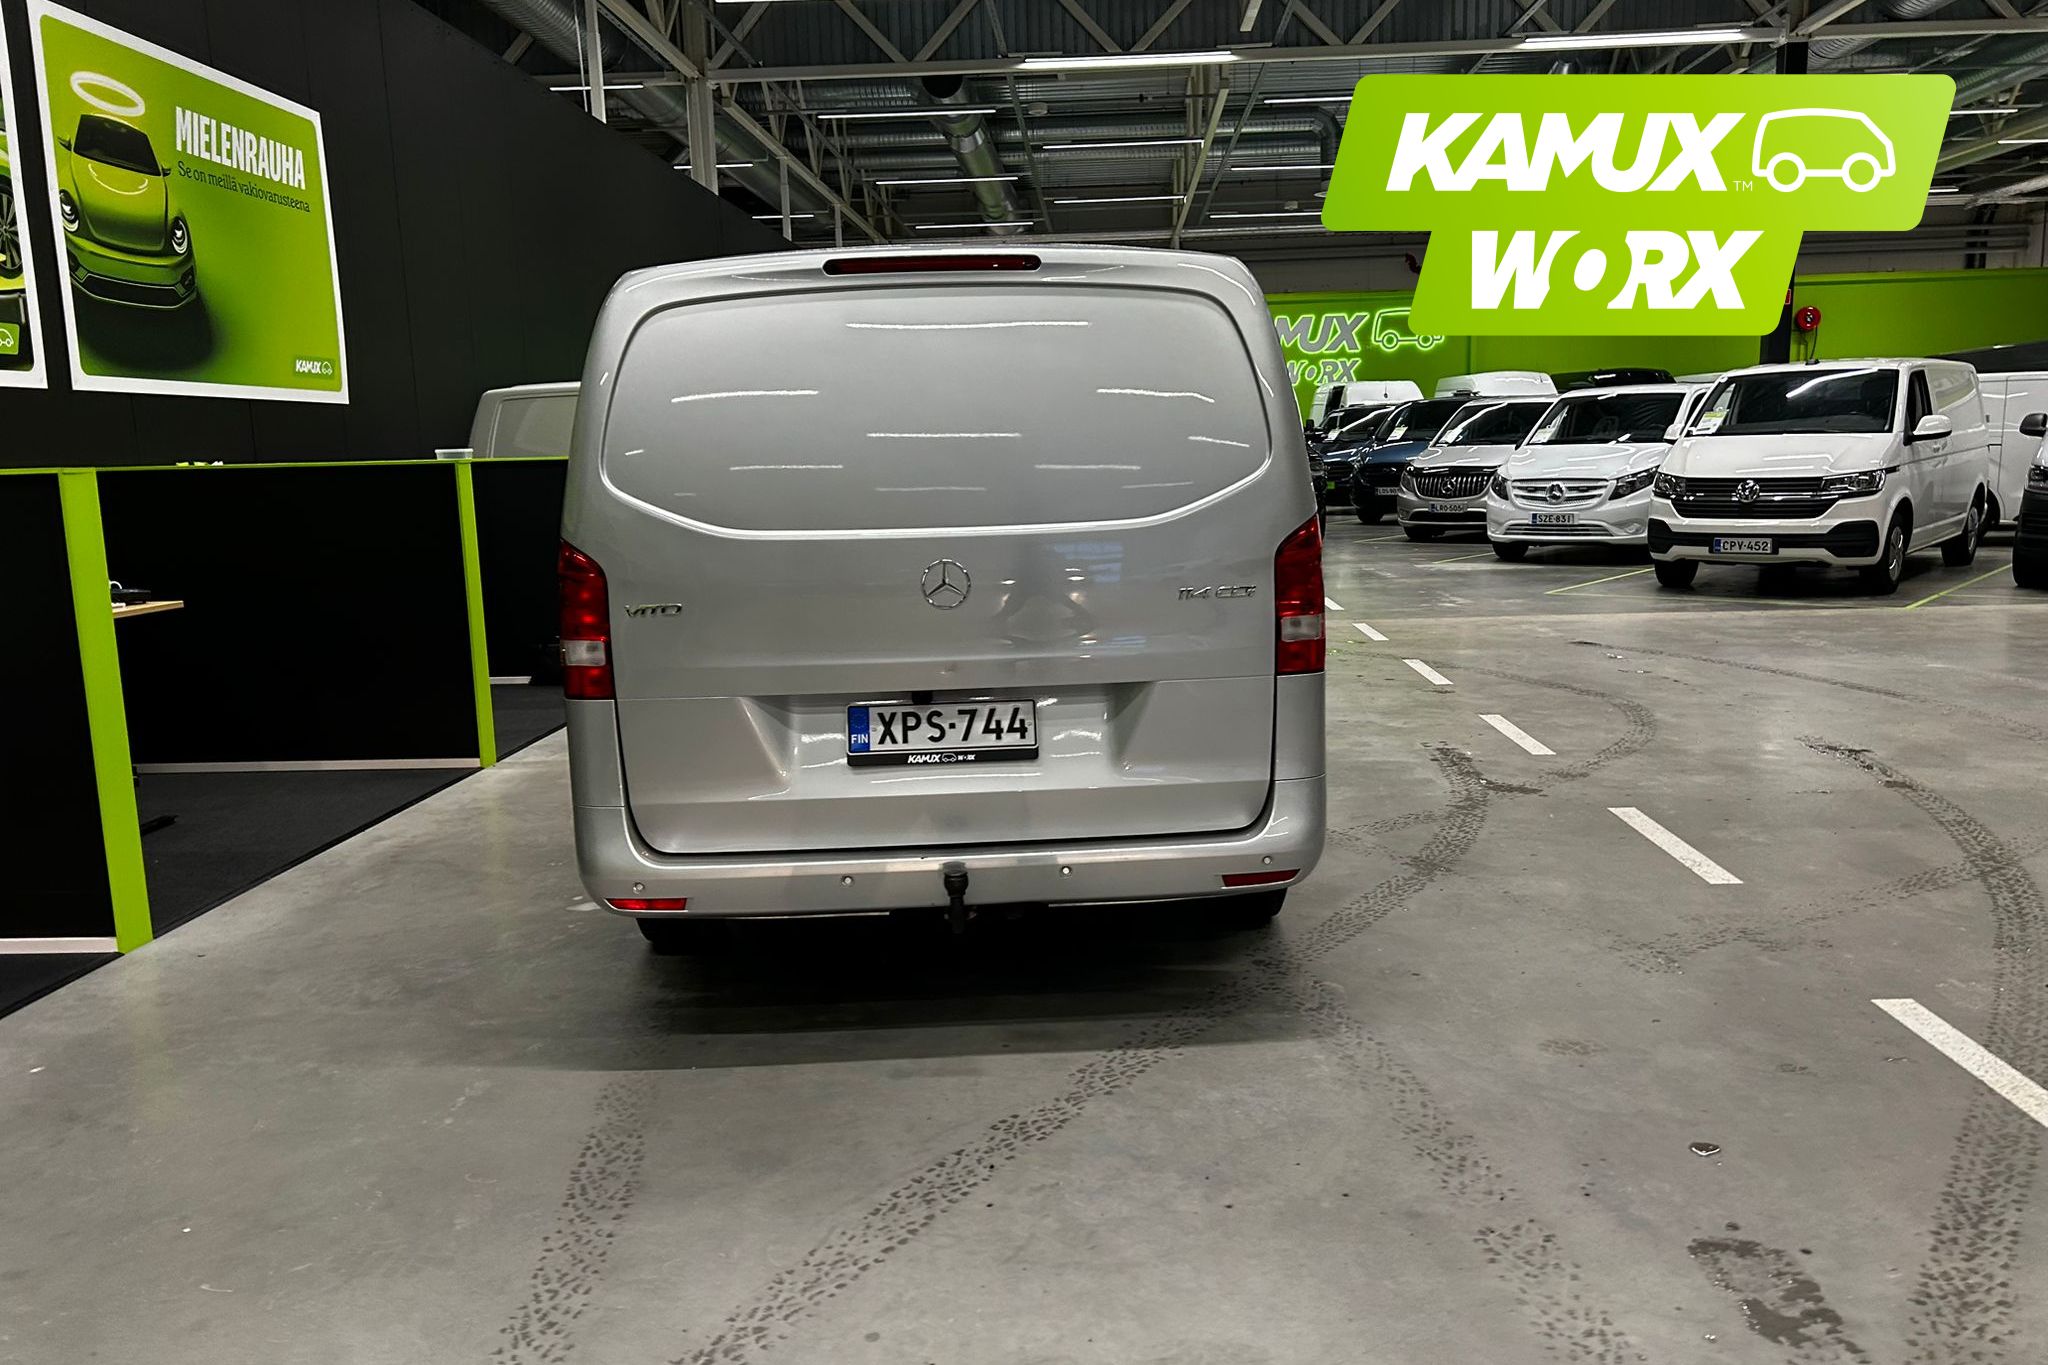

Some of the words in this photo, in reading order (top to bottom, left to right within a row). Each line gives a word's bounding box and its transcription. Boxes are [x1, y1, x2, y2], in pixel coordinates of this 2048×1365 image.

[175, 106, 306, 191] MIELENRAUHA
[177, 160, 193, 179] Se
[193, 169, 207, 183] on
[207, 173, 238, 193] meillä
[238, 182, 310, 213] vakiovarusteena
[1274, 312, 1370, 354] MUX
[295, 359, 321, 374] KAMUX
[1538, 514, 1571, 523] SZE-831
[1722, 540, 1769, 551] CPV-452
[624, 603, 682, 617] VITO
[877, 707, 1028, 745] XPS-744
[851, 733, 869, 744] FIN
[907, 753, 941, 764] KAMUX
